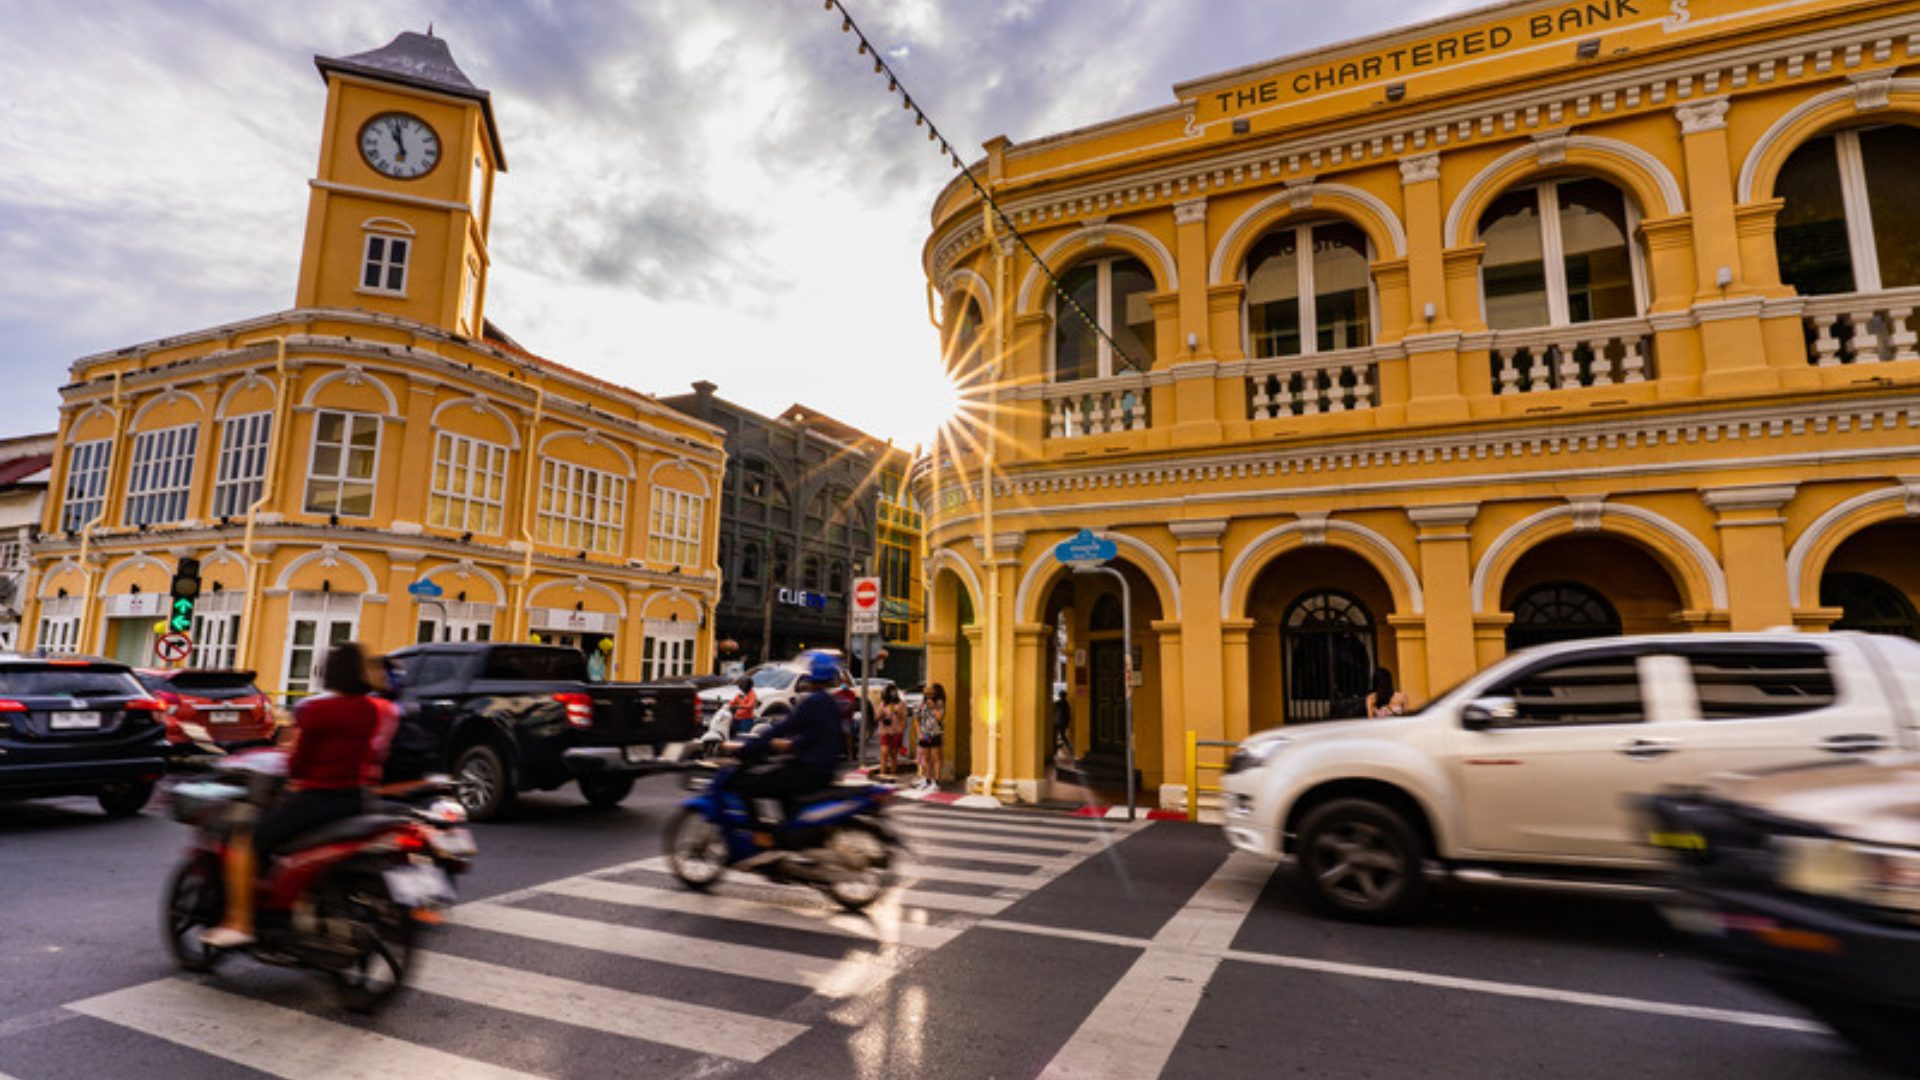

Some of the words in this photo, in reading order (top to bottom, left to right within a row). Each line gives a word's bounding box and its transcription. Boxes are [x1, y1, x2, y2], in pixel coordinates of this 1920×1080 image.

[1216, 81, 1278, 112] THE
[1292, 26, 1512, 93] CHARTERED
[1530, 0, 1639, 38] BANK
